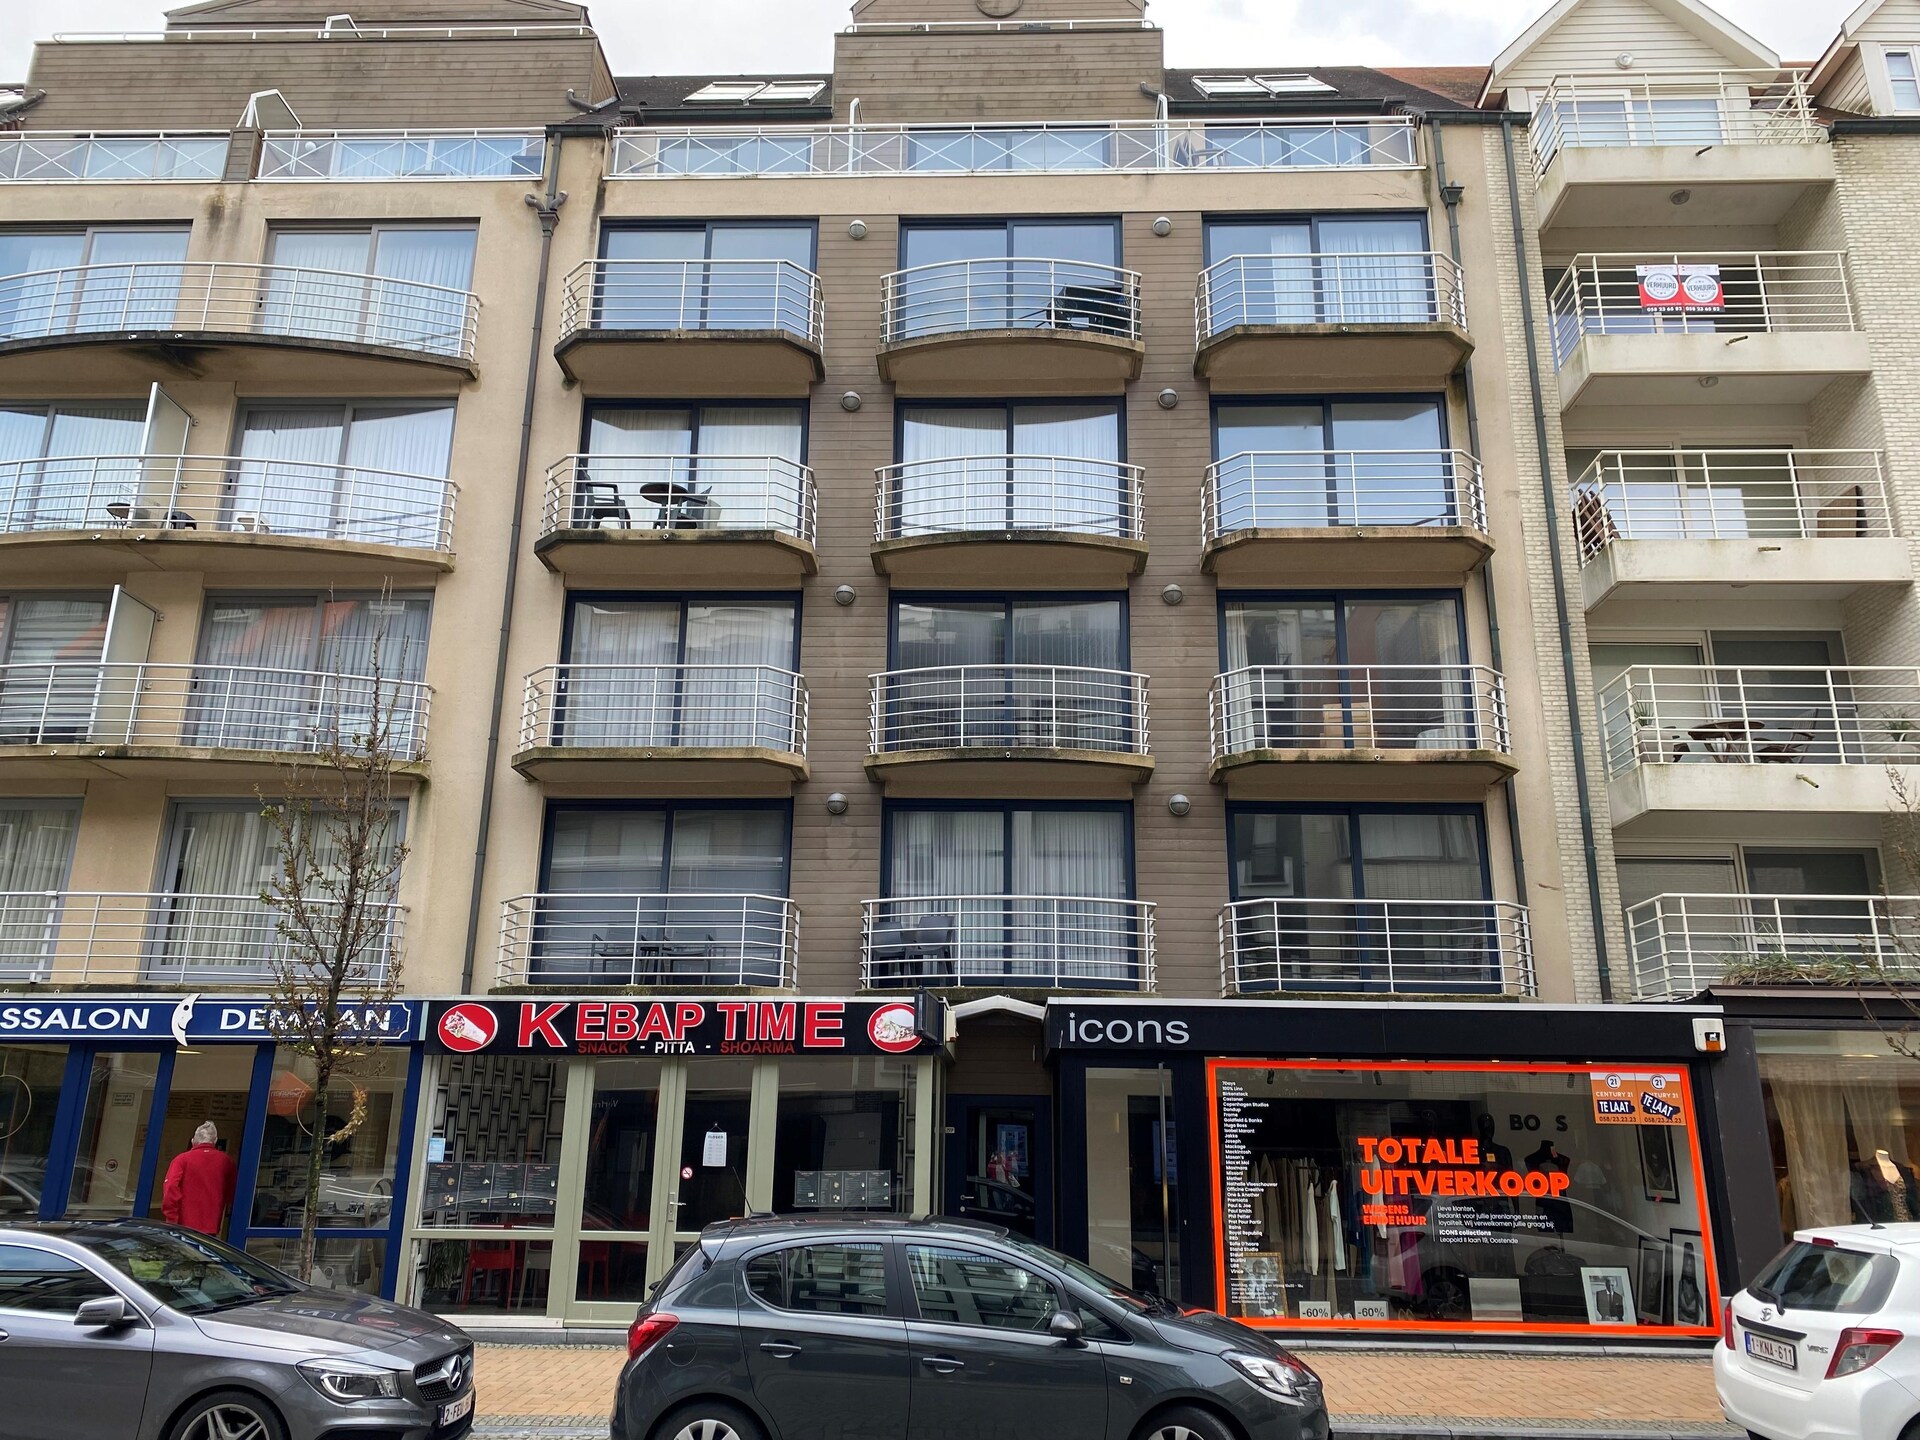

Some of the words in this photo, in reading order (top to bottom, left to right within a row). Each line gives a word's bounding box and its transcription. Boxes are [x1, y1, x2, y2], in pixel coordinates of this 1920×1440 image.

[1686, 284, 1717, 292] VERHUURD
[0, 1008, 149, 1030] SSALON
[517, 1002, 705, 1047] KEBAP
[717, 1002, 845, 1048] TIME
[1069, 1012, 1190, 1044] icons
[578, 1041, 629, 1054] SNACK
[654, 1041, 695, 1054] PITTA
[720, 1041, 795, 1054] SHOARMA
[1599, 1101, 1608, 1112] TE
[1610, 1101, 1629, 1113] LAAT
[1643, 1094, 1653, 1107] TE
[1652, 1099, 1673, 1117] LAAT
[1358, 1137, 1480, 1165] TOTALE
[1361, 1170, 1570, 1197] UITVERKOOP
[1362, 1204, 1409, 1215] WEGENS
[1363, 1215, 1395, 1225] EINDE
[1396, 1215, 1427, 1225] HUUR
[1490, 1213, 1521, 1221] jarenlange
[1464, 1220, 1473, 1228] Wij
[1302, 1308, 1328, 1317] -60%
[1358, 1307, 1384, 1317] -60%
[1751, 1337, 1792, 1363] 1-KNA-611
